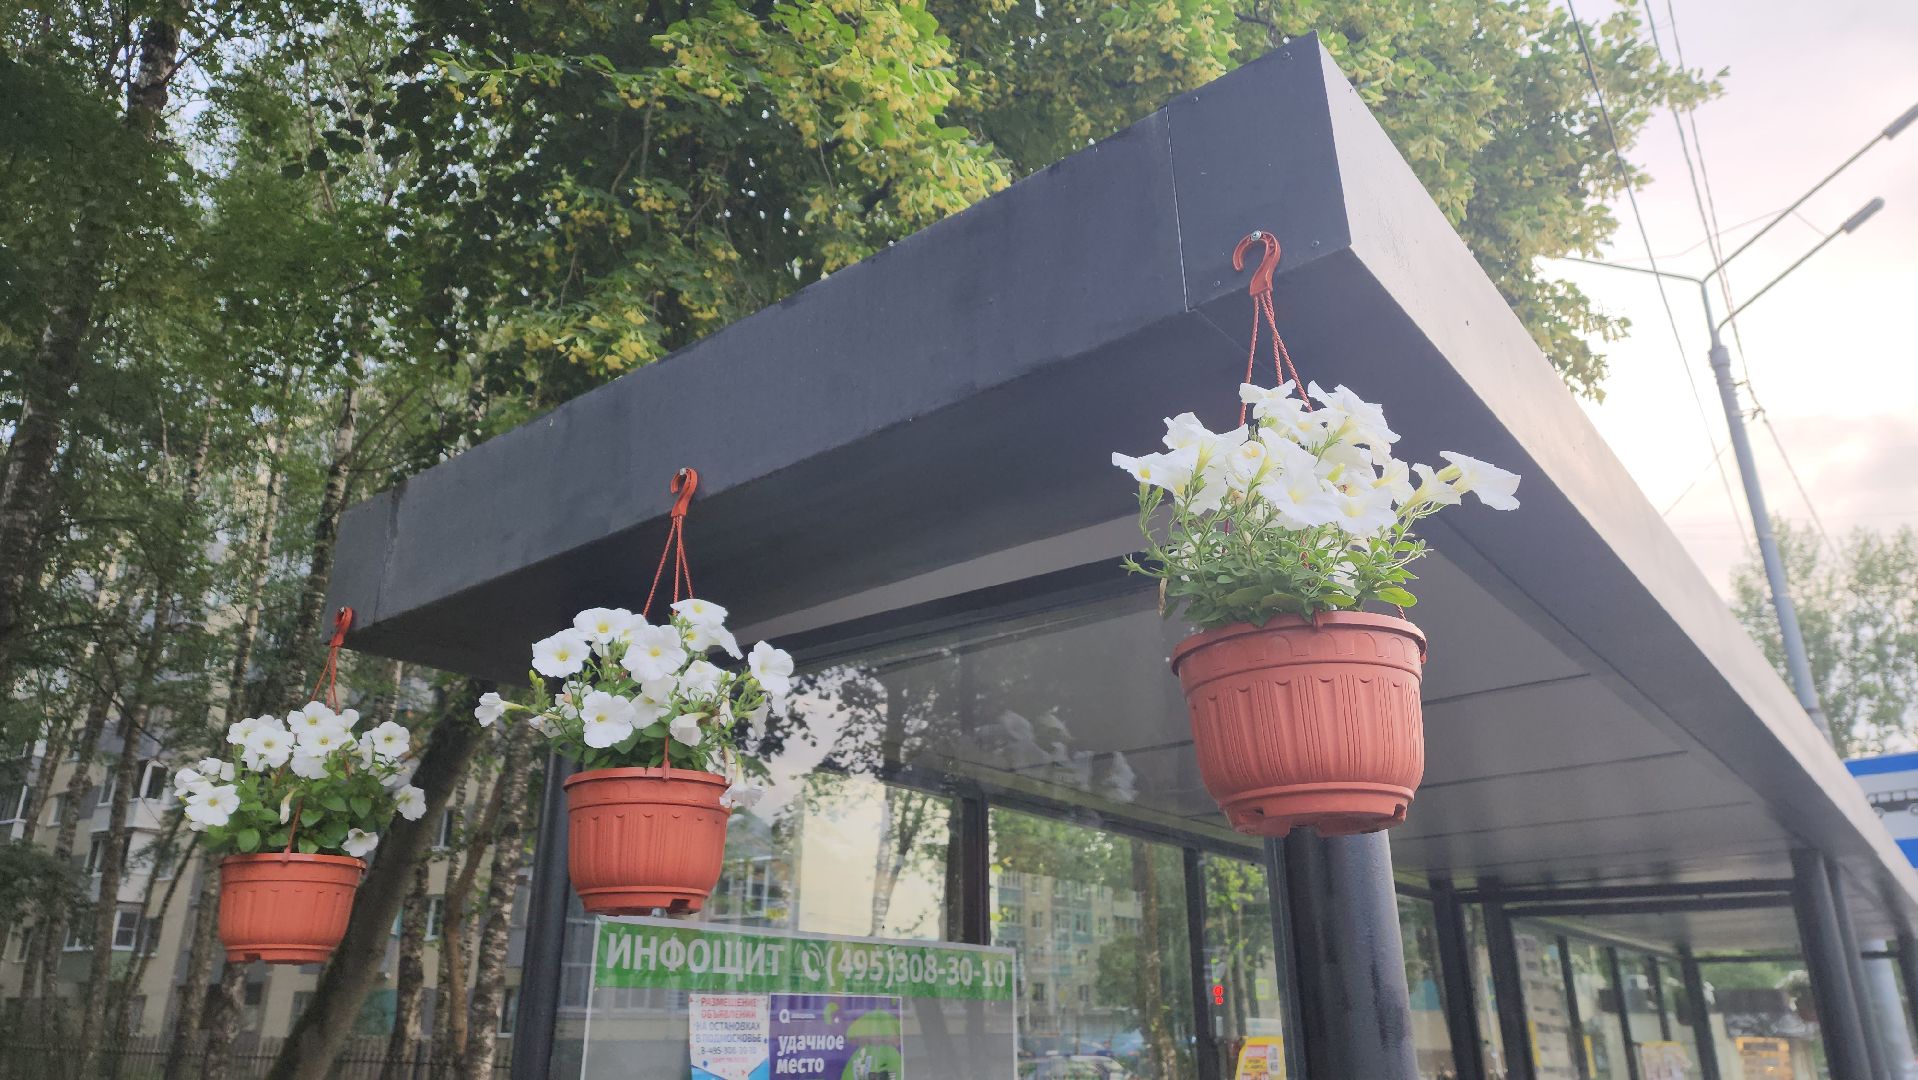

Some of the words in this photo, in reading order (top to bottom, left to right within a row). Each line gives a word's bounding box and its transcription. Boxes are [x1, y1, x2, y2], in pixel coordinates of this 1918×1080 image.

[606, 931, 785, 982] ИНФОЩИТ
[824, 946, 1006, 988] (495)308-30-10
[701, 997, 757, 1007] РАЗМЕЩЕНИЕ
[709, 1021, 760, 1031] ОСТАНОВКАХ
[703, 1033, 762, 1043] ПОДМОСКОВЬЕ
[777, 1035, 844, 1057] удачное
[776, 1057, 825, 1074] место
